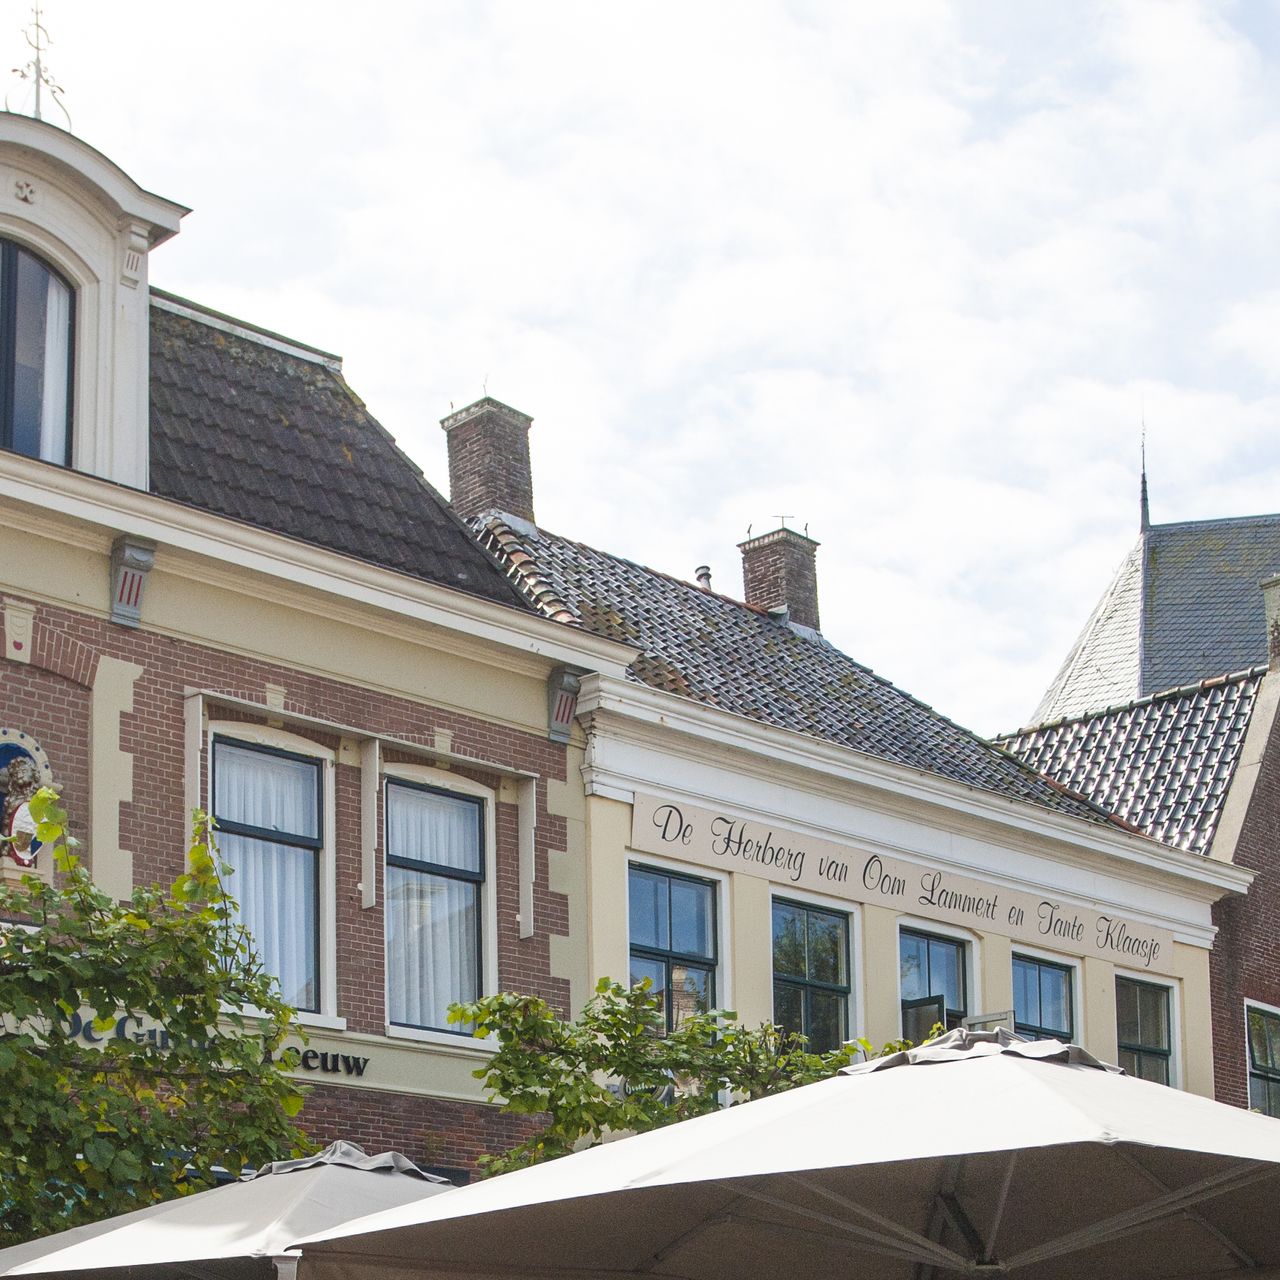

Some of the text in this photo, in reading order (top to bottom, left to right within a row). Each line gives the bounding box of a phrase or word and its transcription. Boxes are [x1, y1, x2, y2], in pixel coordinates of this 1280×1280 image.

[652, 804, 1161, 967] De Herberg van Oom Lammert en Tante Klaasje
